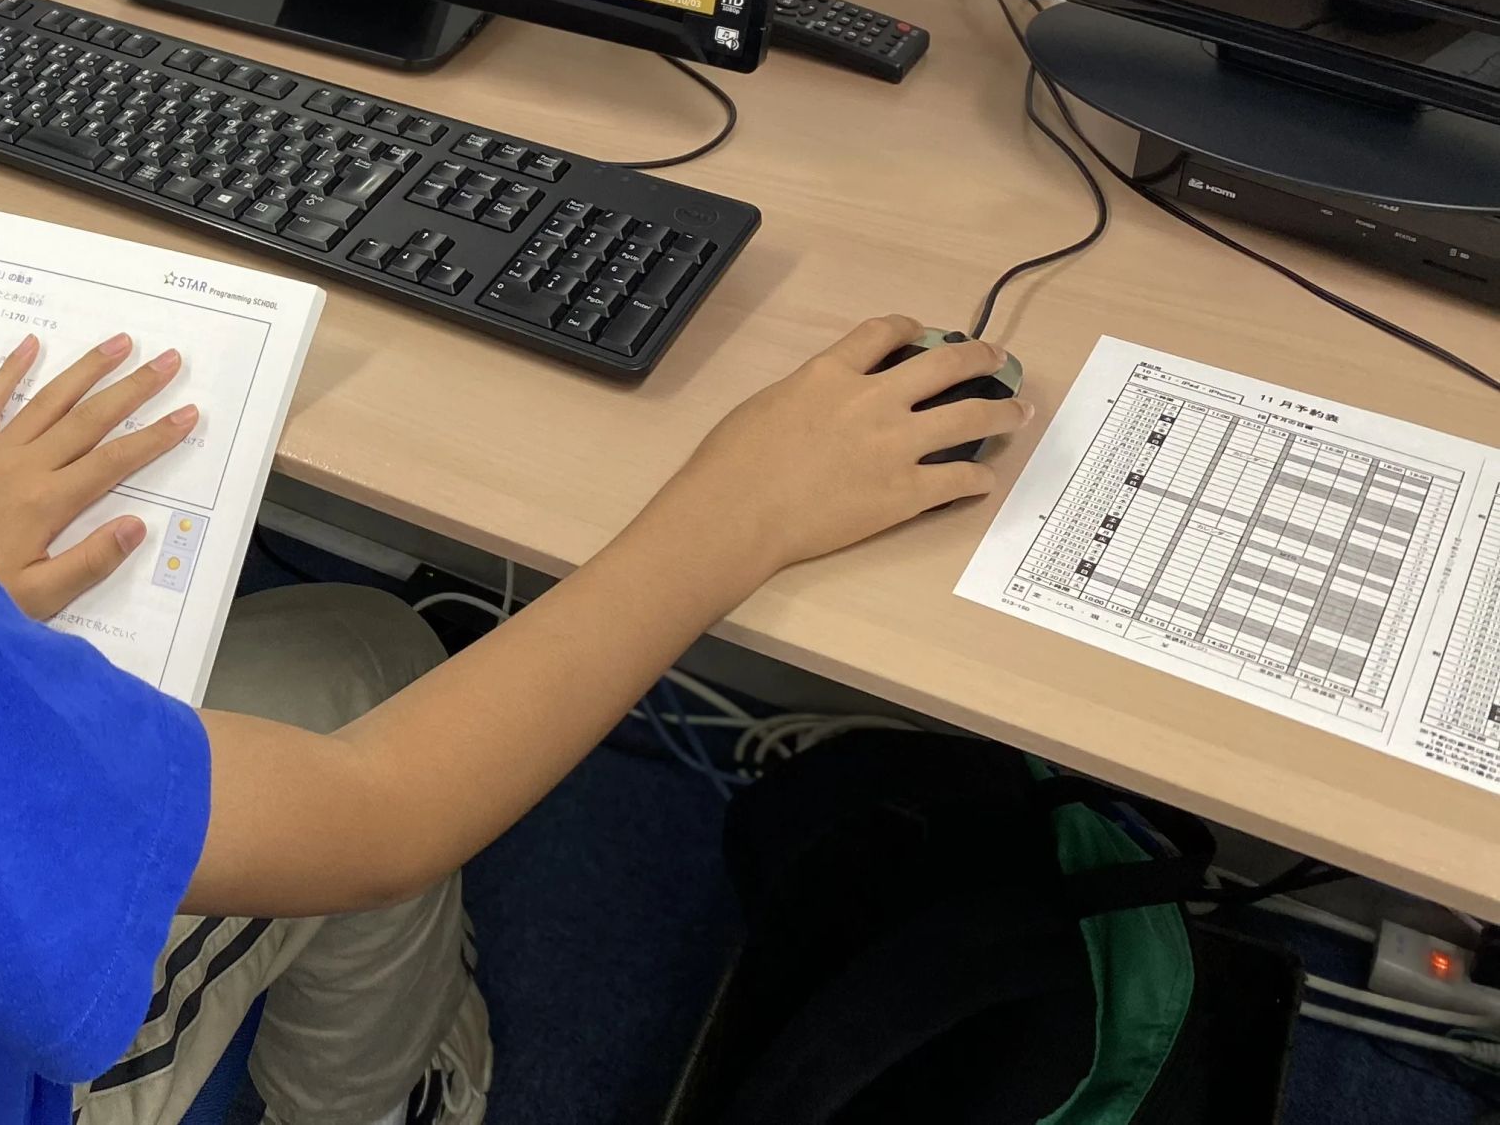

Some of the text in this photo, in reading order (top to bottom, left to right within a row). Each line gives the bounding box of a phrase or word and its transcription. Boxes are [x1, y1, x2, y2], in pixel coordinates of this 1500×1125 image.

[566, 204, 581, 212] Lock
[569, 200, 585, 208] Num
[544, 228, 564, 238] Home
[621, 252, 640, 262] PgUp
[508, 269, 522, 278] End
[178, 276, 278, 310] STAR Programming SCHOOL
[586, 295, 605, 306] PgDn
[633, 300, 652, 310] Enter
[567, 318, 580, 327] Del
